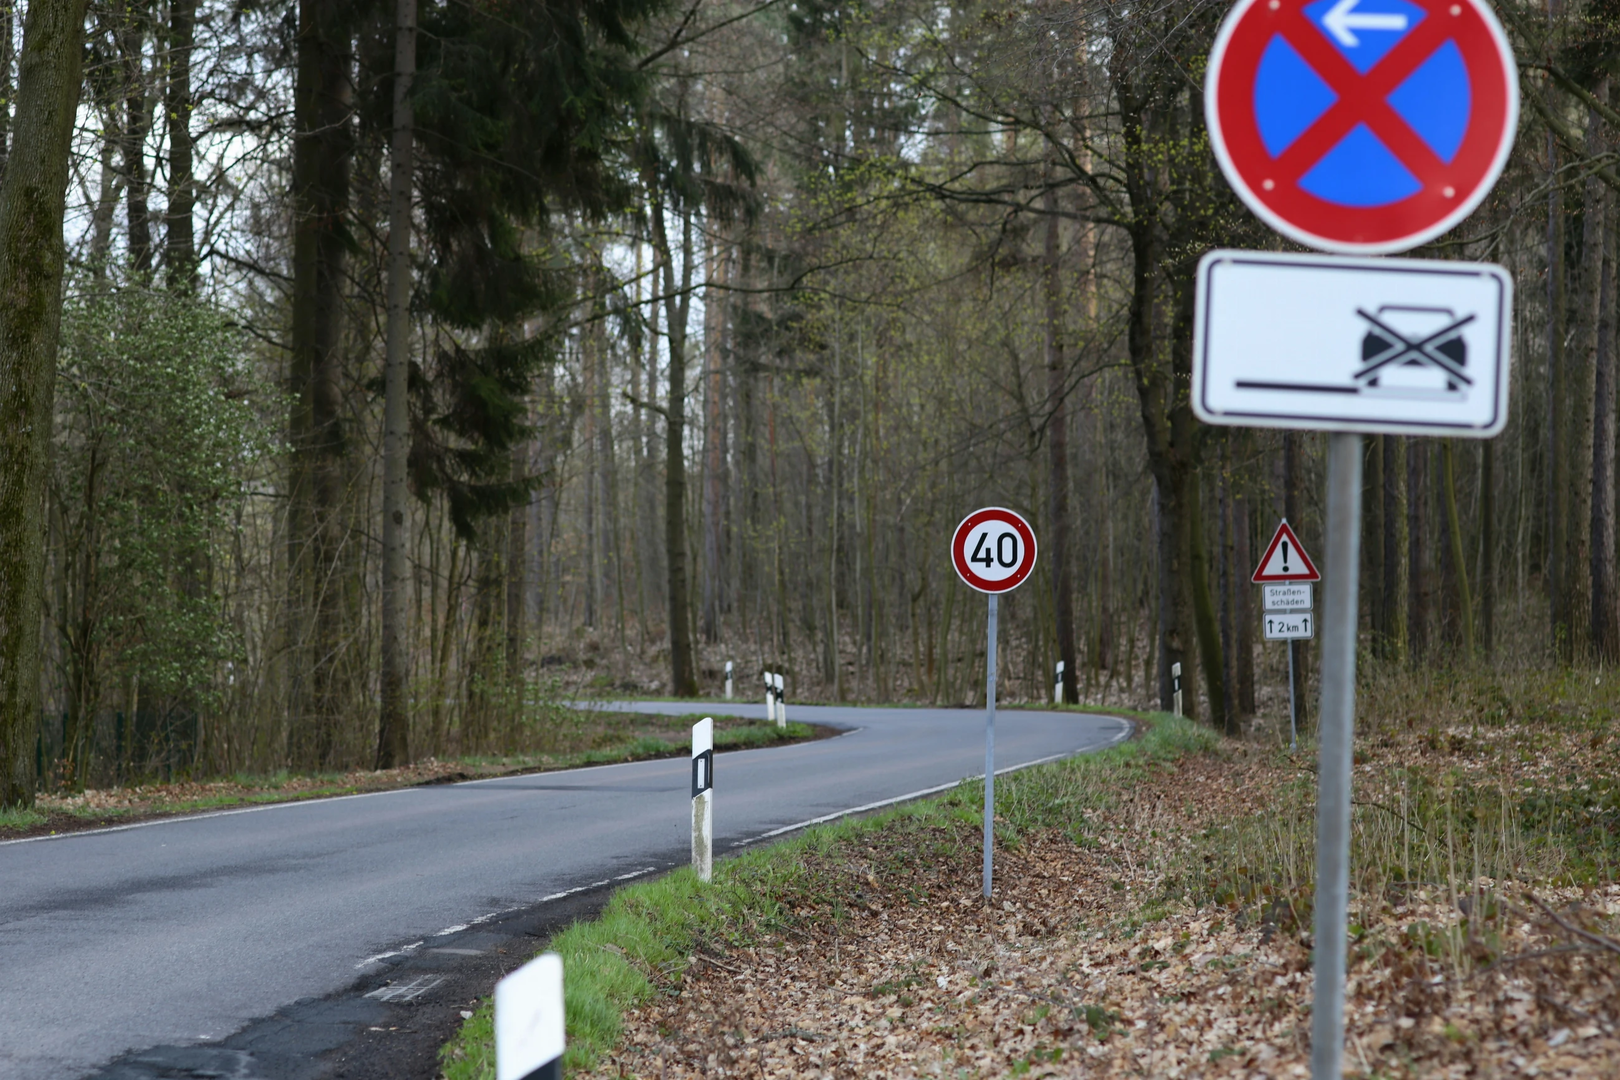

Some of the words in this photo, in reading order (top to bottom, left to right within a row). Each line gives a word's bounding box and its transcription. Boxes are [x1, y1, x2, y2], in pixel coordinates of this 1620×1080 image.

[970, 532, 1018, 568] 40
[1270, 588, 1305, 597] Straßen-
[1271, 598, 1305, 607] schäden
[1278, 621, 1285, 633] 2
[1286, 622, 1299, 633] km
